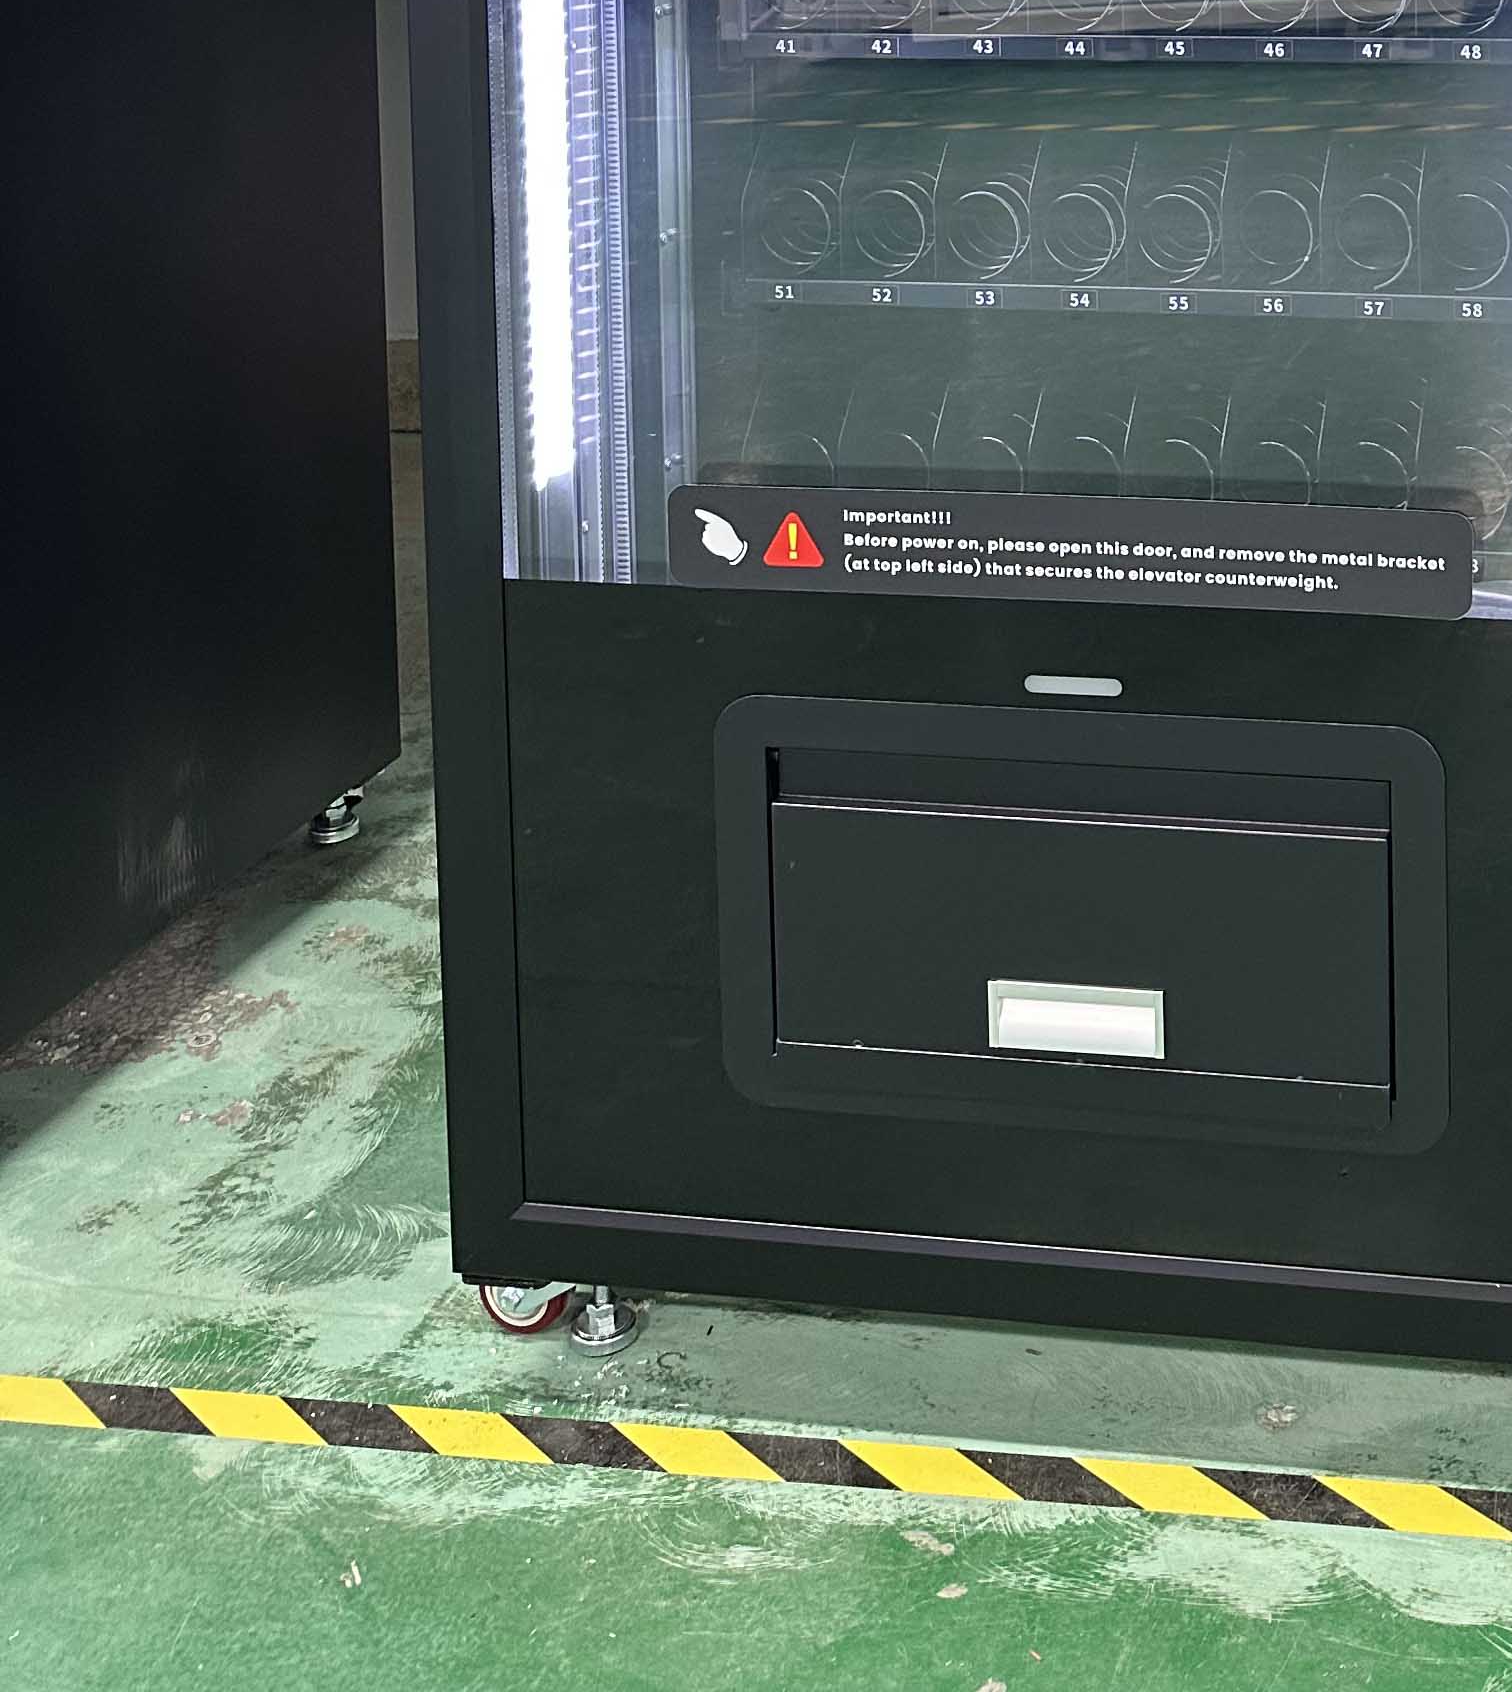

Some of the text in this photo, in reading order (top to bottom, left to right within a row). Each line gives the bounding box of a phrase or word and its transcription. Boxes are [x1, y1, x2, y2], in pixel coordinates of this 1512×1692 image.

[775, 39, 796, 54] 41
[871, 39, 892, 54] 42
[973, 39, 994, 54] 43
[1064, 41, 1085, 55] 44
[1164, 41, 1185, 56] 45
[1263, 43, 1285, 57] 46
[1362, 43, 1383, 58] 47
[1460, 45, 1482, 60] 48
[775, 285, 794, 299] 51
[872, 288, 892, 302] 52
[975, 290, 995, 305] 53
[1069, 292, 1090, 307] 54
[1168, 296, 1189, 311] 55
[1263, 298, 1284, 313] 56
[1363, 301, 1385, 316] 57
[1462, 303, 1483, 318] 58
[843, 509, 952, 526] Important!!!
[843, 533, 1446, 571] Before power on, please open this door, and remove the metal bracket
[844, 553, 1339, 592] (at top left side) that secures the elevator counterweight.
